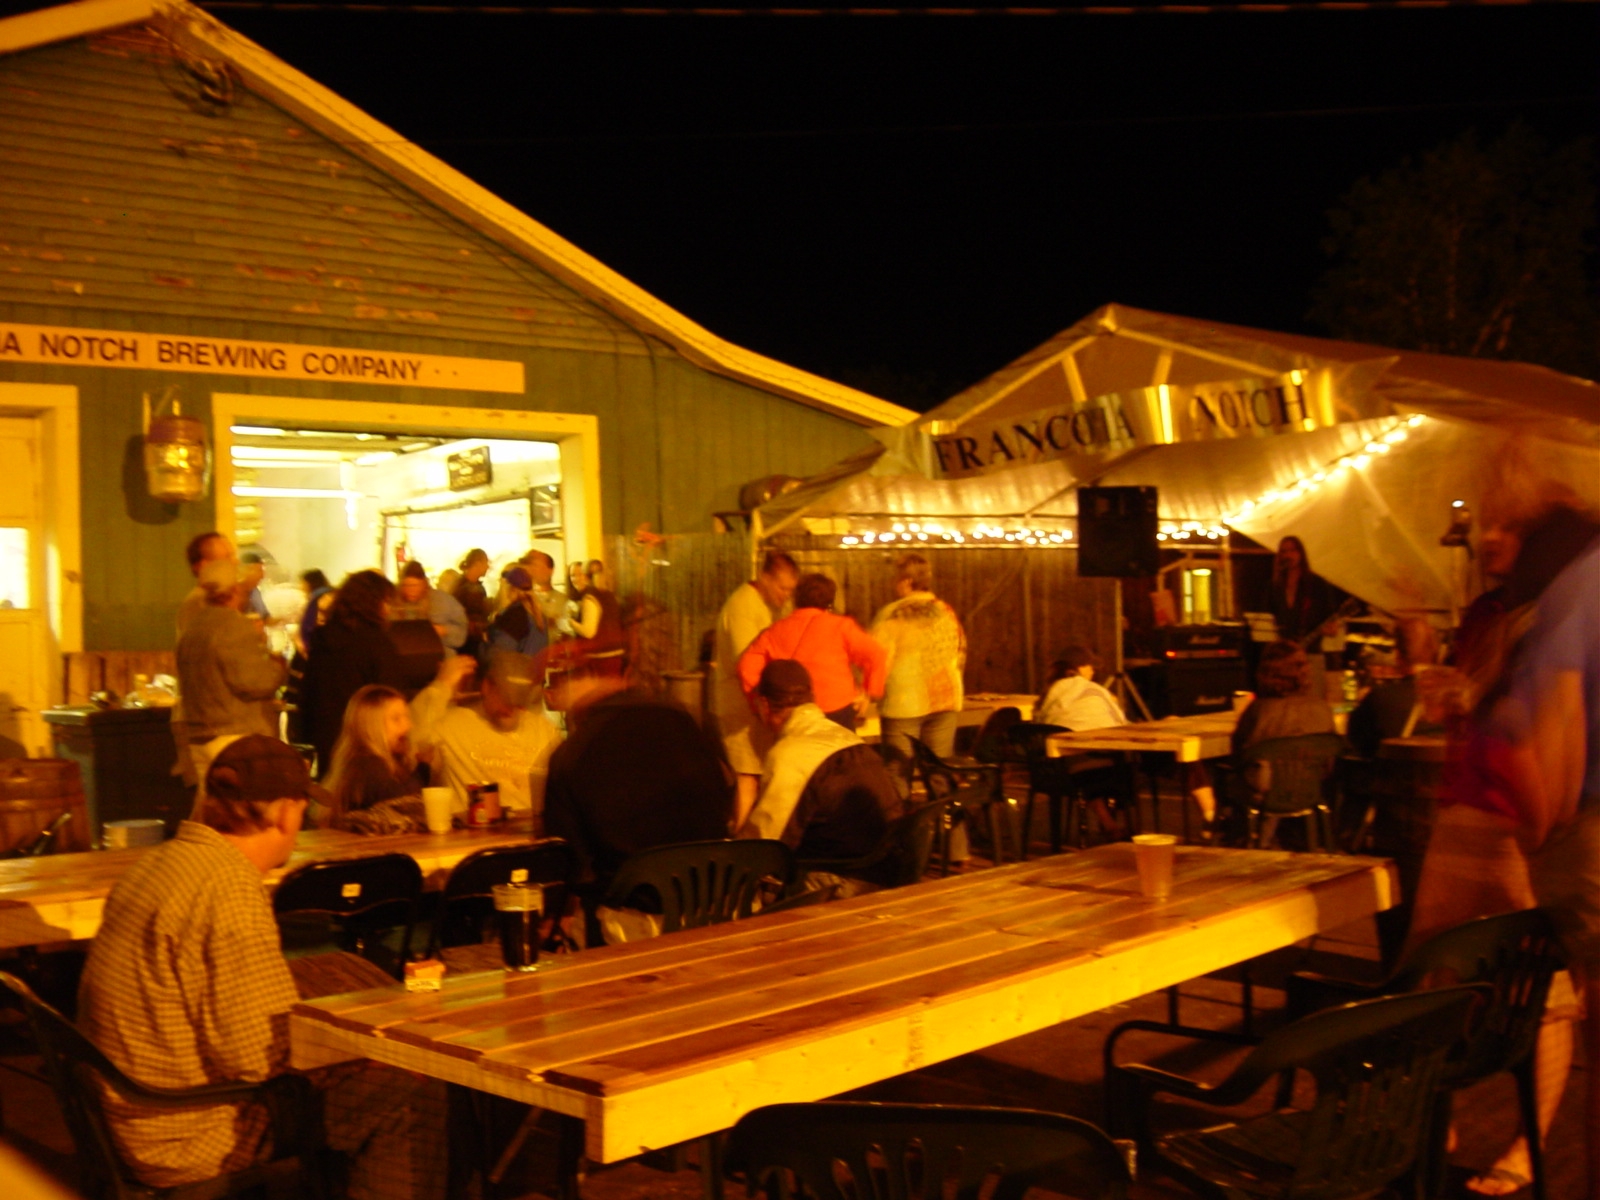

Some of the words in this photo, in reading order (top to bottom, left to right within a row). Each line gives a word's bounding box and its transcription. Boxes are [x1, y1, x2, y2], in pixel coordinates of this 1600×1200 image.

[39, 333, 138, 361] NOTCH
[157, 340, 287, 371] BREWING
[302, 353, 422, 380] COMPANY
